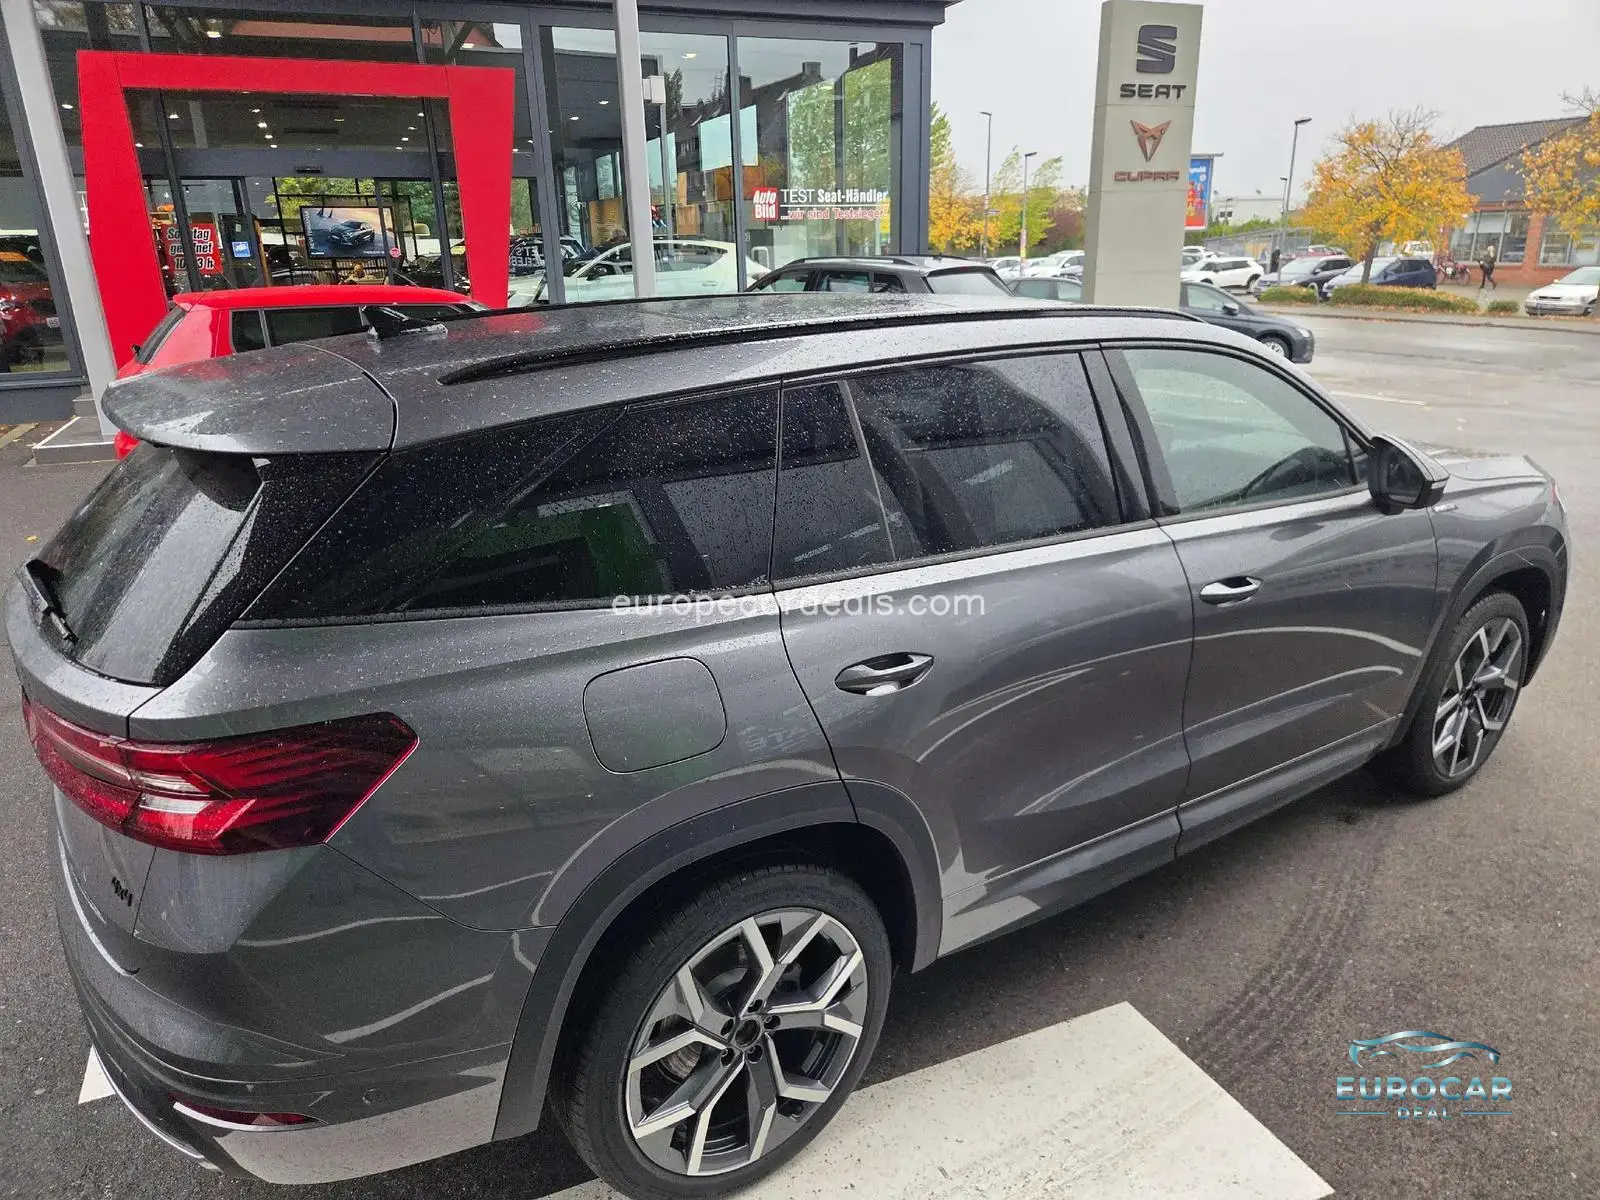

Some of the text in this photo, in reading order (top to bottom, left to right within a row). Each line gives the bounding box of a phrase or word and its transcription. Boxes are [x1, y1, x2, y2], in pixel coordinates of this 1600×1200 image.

[1119, 83, 1187, 99] SEAT
[1114, 170, 1180, 182] CUPRA
[753, 190, 777, 204] Auto
[781, 188, 888, 203] TEST Seat-Händler
[754, 203, 776, 219] Bild
[807, 207, 830, 219] sind
[167, 227, 211, 241] Sotag
